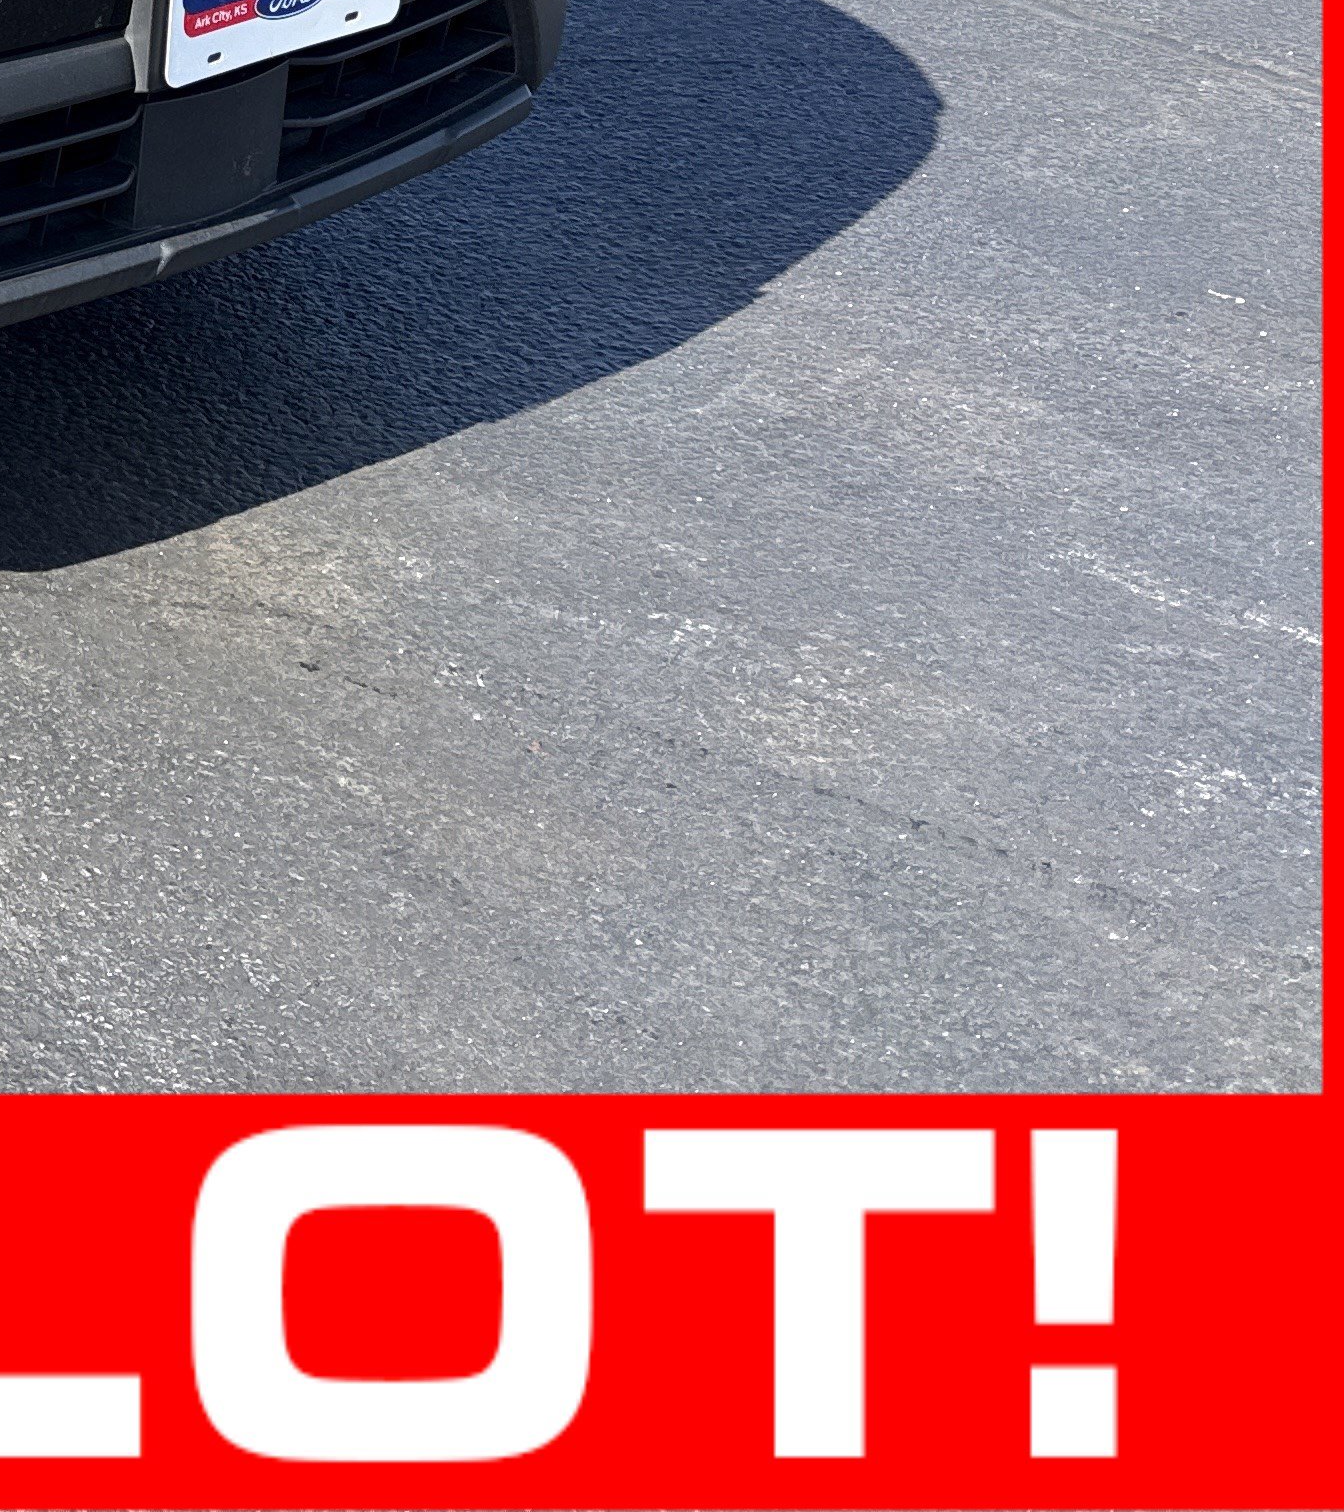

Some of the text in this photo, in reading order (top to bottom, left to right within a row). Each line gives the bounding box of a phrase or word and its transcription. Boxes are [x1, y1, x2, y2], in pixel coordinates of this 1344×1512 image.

[194, 3, 248, 30] Ark City, KS
